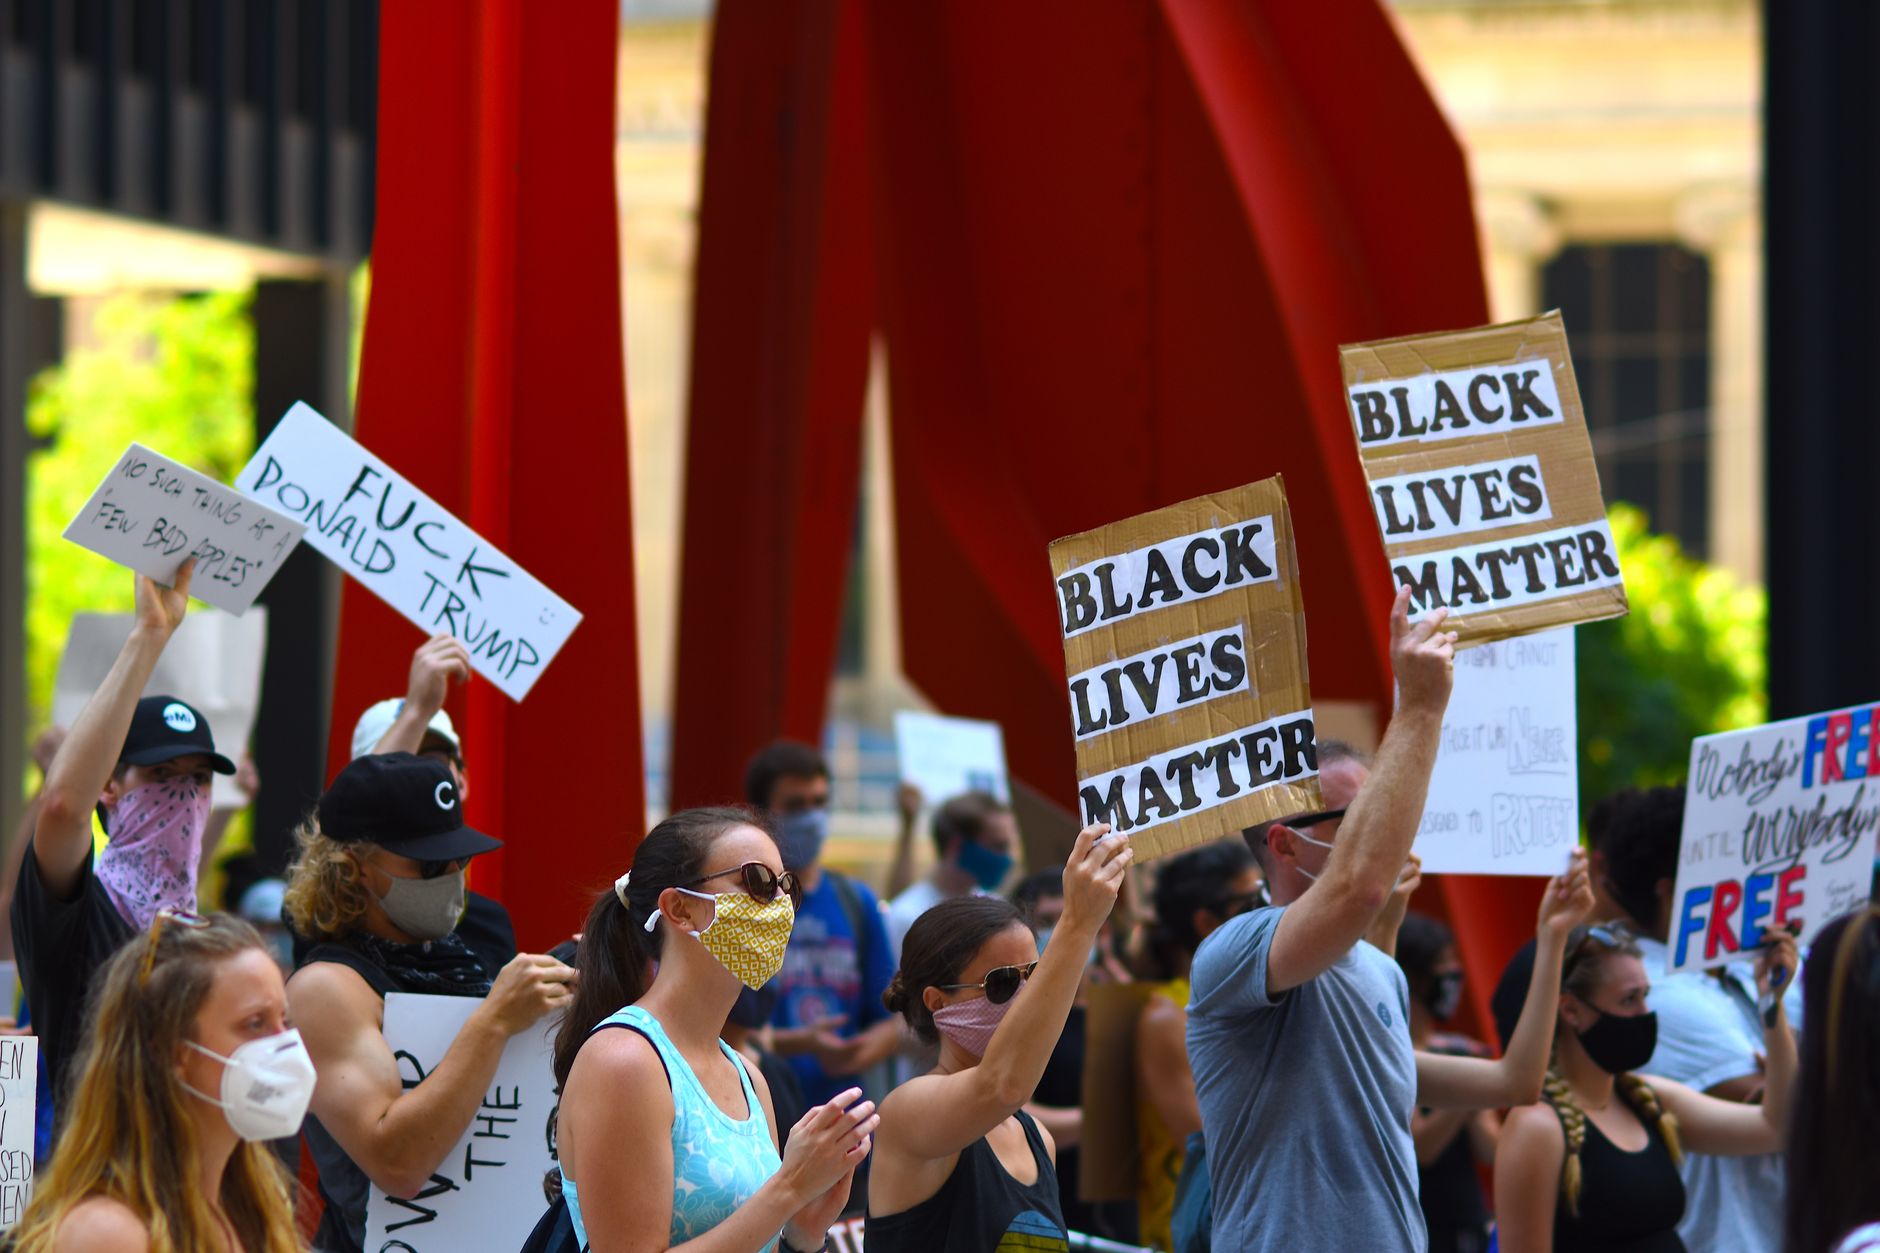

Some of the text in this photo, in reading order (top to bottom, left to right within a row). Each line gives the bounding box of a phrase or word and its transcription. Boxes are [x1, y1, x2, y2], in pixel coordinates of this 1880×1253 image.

[1352, 369, 1554, 442] BLACK
[121, 457, 148, 478] NO
[149, 468, 185, 498] SUCH
[192, 487, 241, 525] THING
[273, 531, 291, 562] A
[143, 517, 188, 556] BAD
[253, 455, 396, 574] DONALD
[344, 464, 511, 601] FUCK
[1375, 464, 1544, 535] LIVES
[1057, 523, 1273, 634] BLACK
[1393, 529, 1621, 615] MATTER
[419, 571, 540, 680] TRUMP
[1070, 633, 1246, 736] LIVES
[1080, 718, 1318, 832] MATTER
[1507, 705, 1568, 771] NEVER
[434, 780, 456, 810] C
[1416, 792, 1574, 858] ESIGNED TO PROTECT
[1674, 864, 1806, 968] FREE
[464, 1085, 523, 1182] THE
